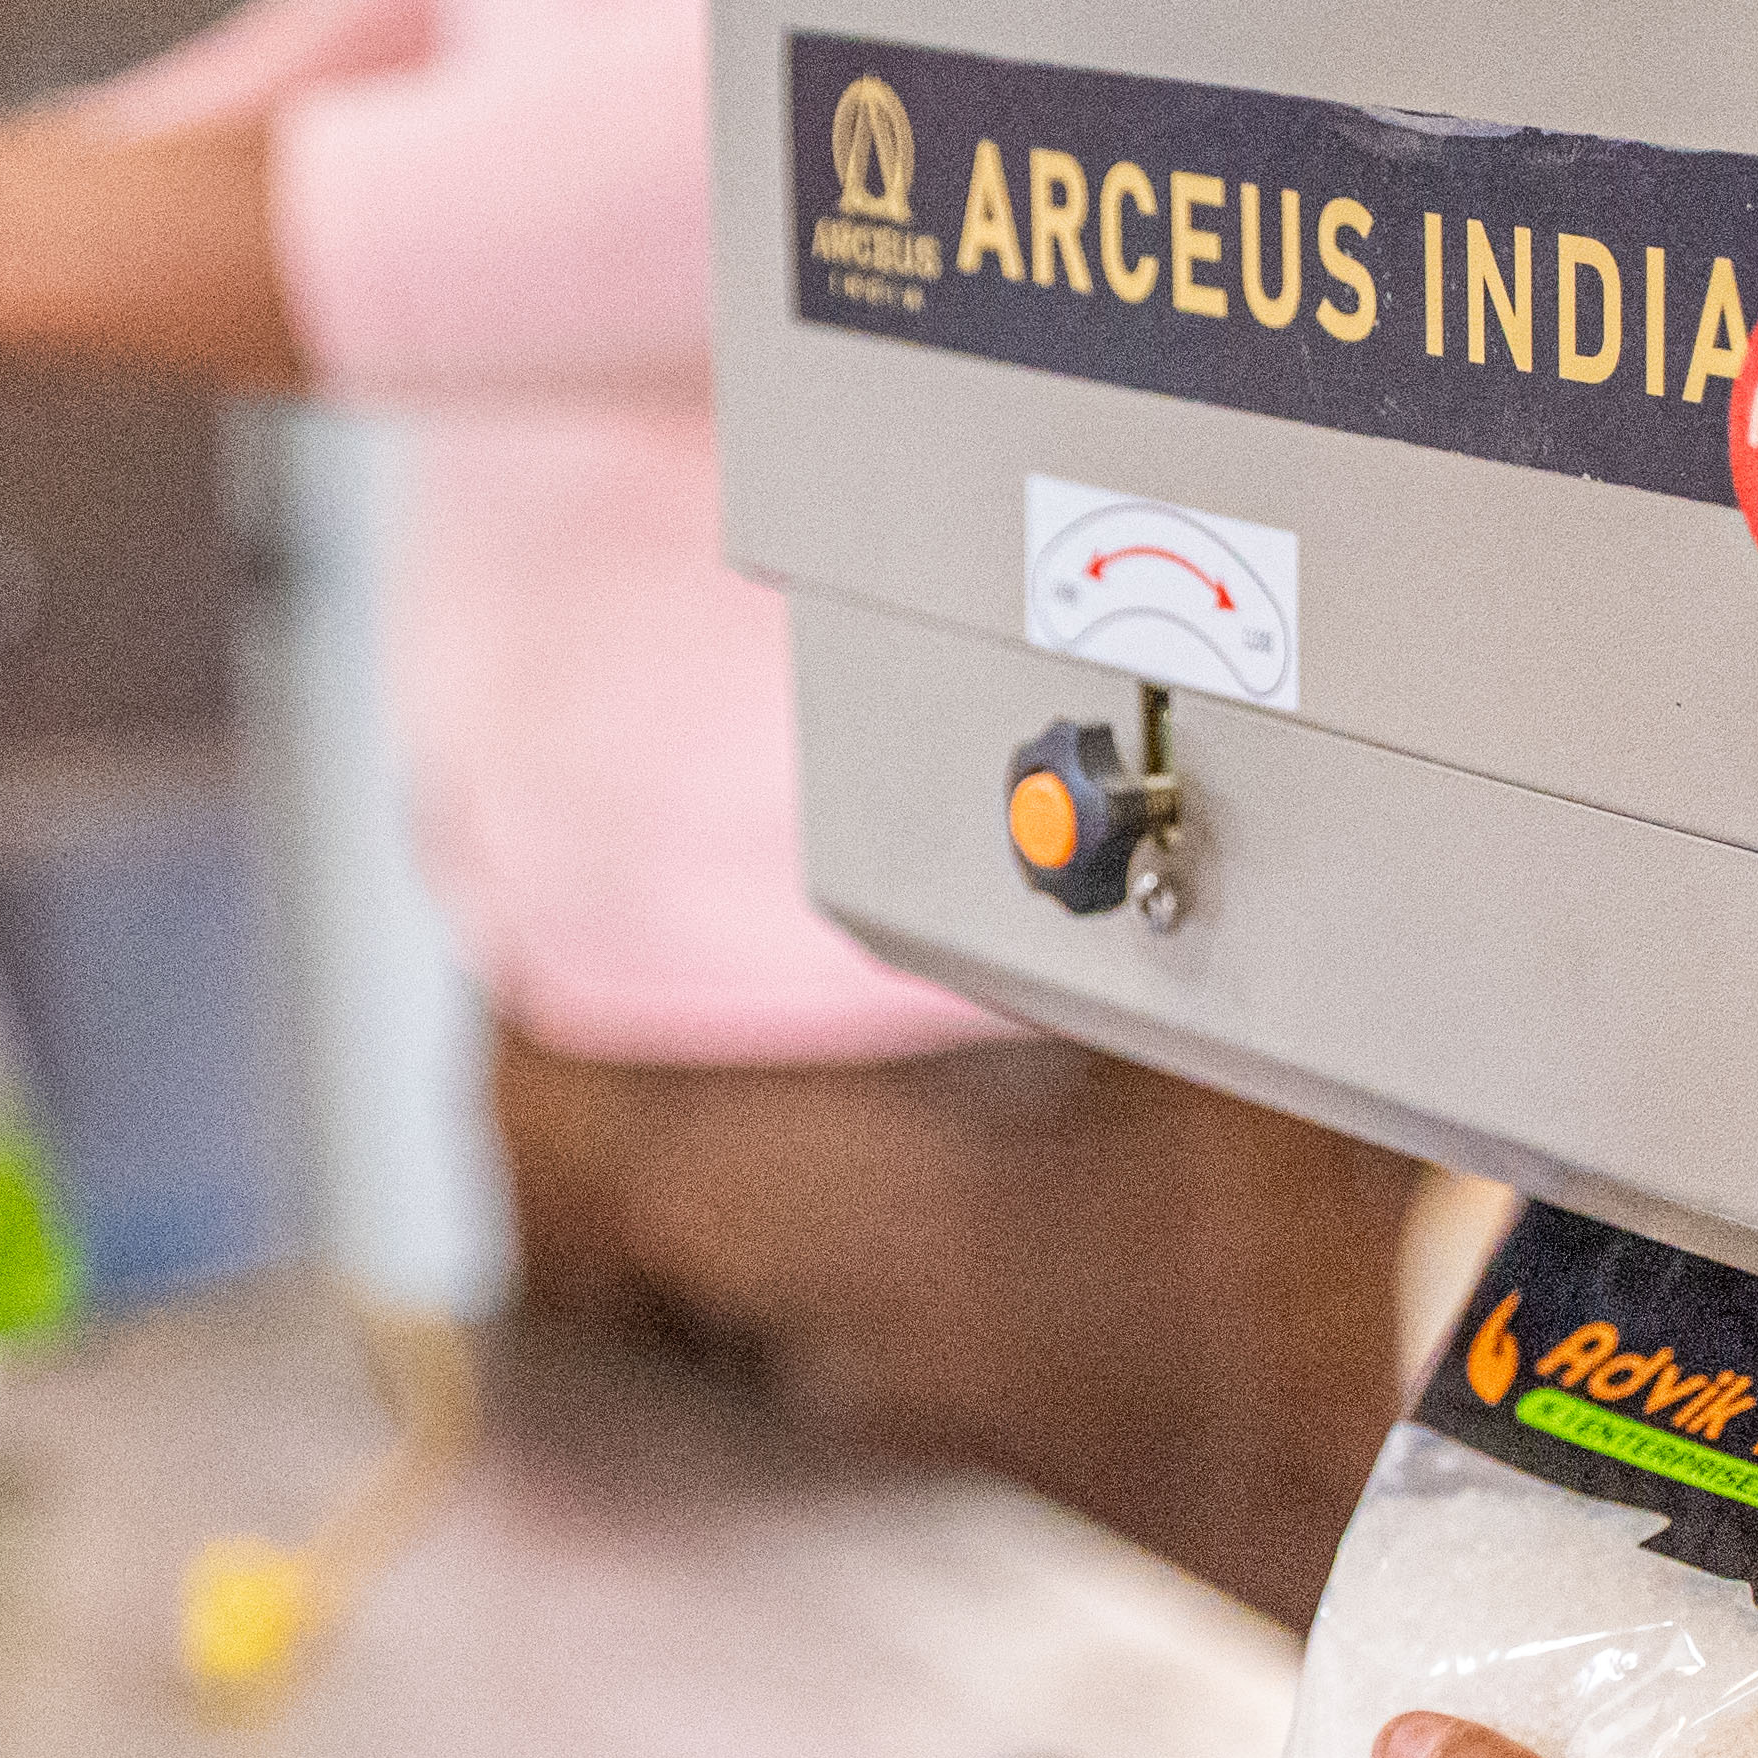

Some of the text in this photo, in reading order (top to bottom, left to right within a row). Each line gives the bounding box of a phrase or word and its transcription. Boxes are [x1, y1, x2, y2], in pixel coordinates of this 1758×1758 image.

[956, 138, 1750, 404] ARCEUS INDIA
[1535, 1320, 1757, 1441] Advik
